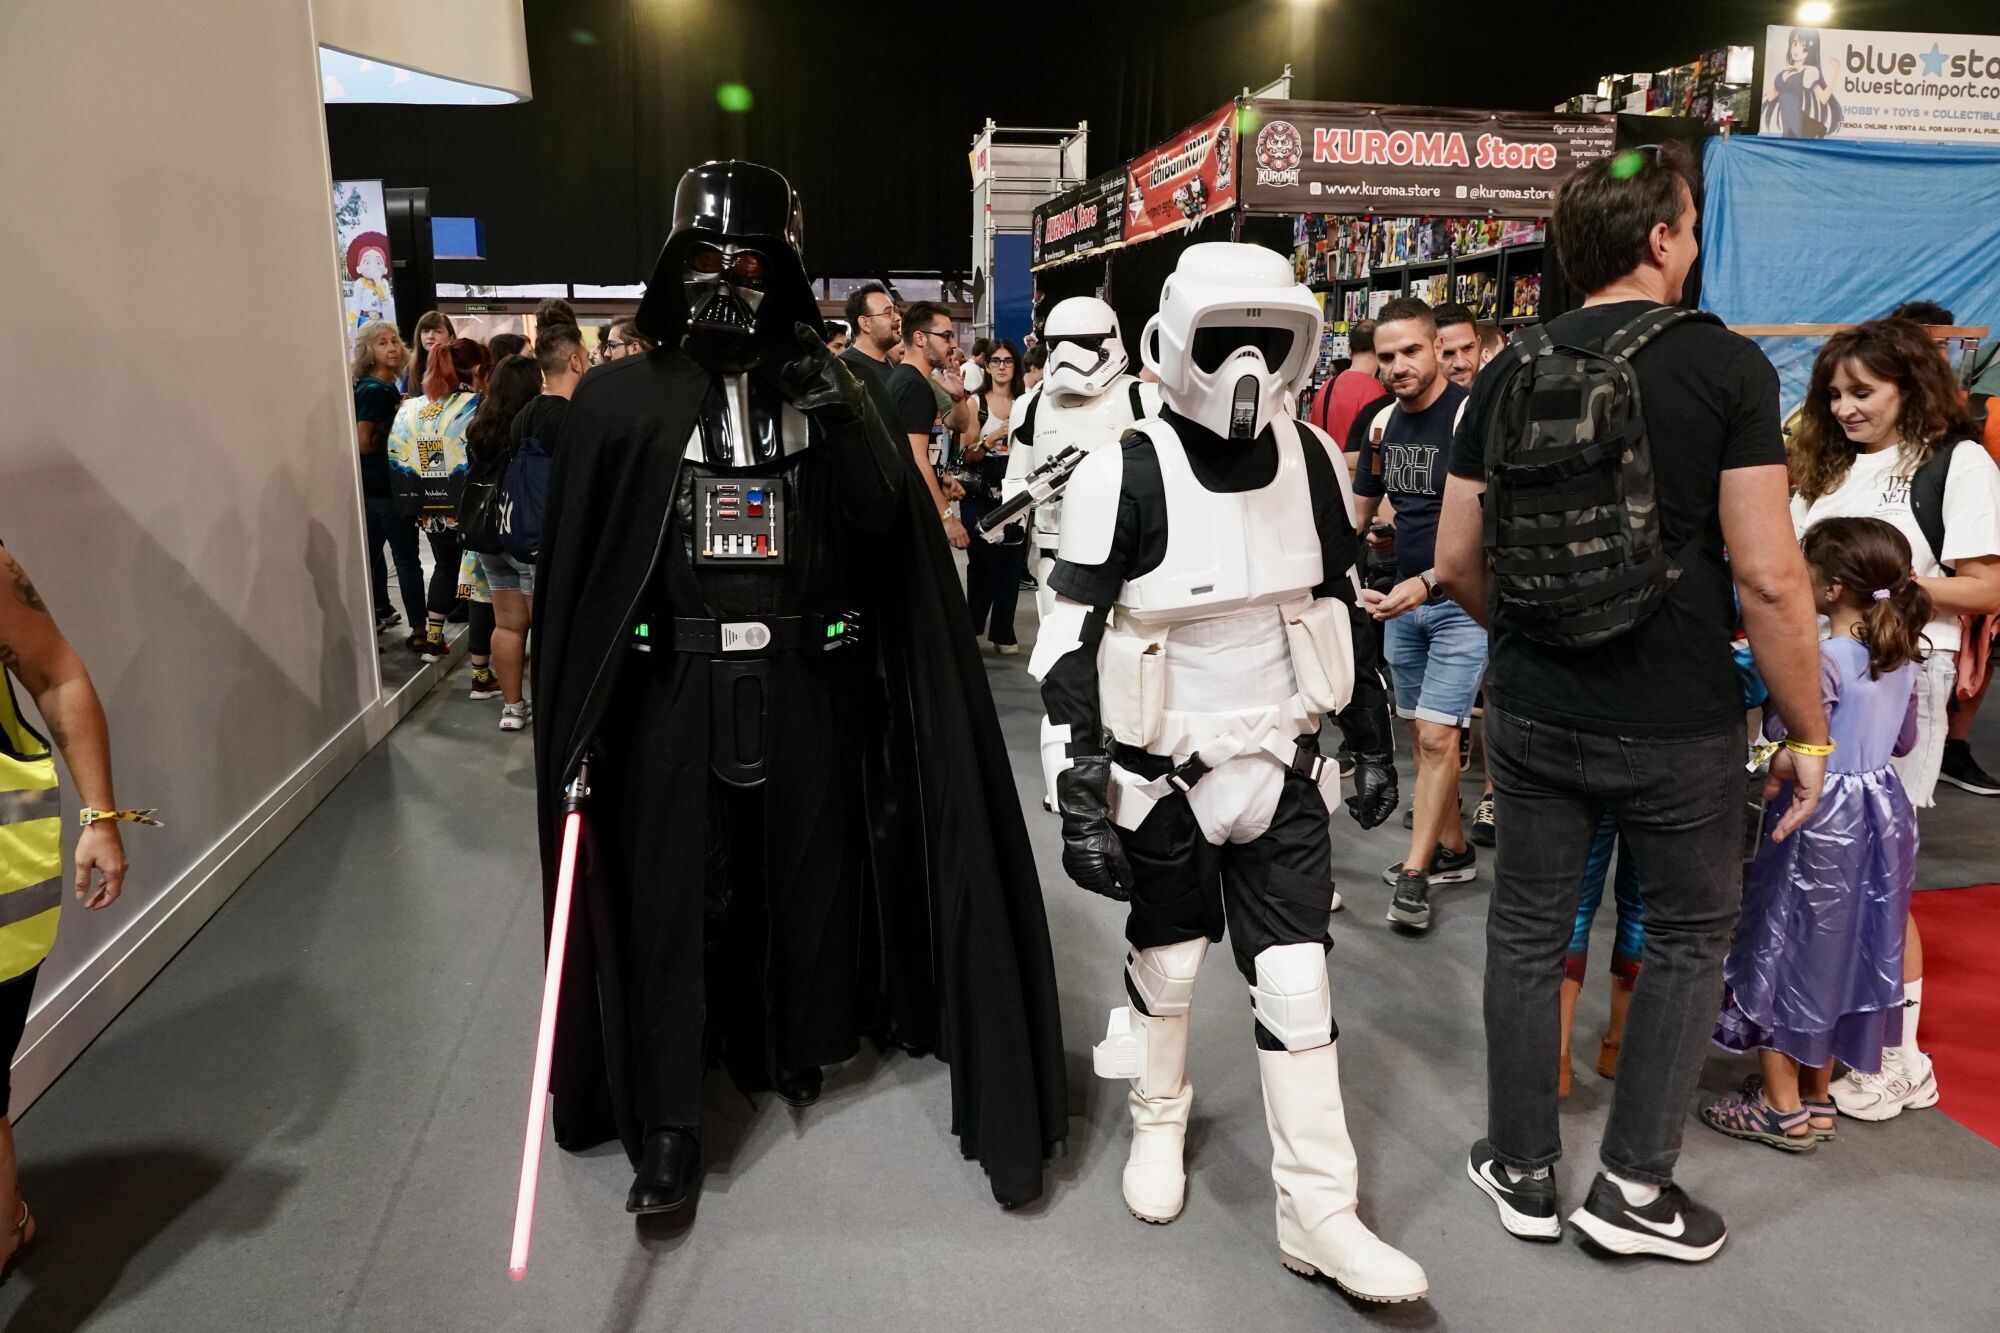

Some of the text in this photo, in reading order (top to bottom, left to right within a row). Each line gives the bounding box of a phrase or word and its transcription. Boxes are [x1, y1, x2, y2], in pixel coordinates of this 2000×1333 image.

[1846, 43, 1917, 76] blue
[1843, 105, 1881, 116] HOBBY
[1892, 107, 1920, 118] TOYS
[1553, 125, 1614, 135] figuras de colección
[1313, 128, 1557, 169] KUROMA Store
[1259, 170, 1298, 183] KUROMA
[1326, 181, 1556, 200] www.kuroma.store @kuroma.store
[1076, 202, 1098, 232] Store
[427, 440, 444, 451] CON
[418, 442, 430, 472] COMIC
